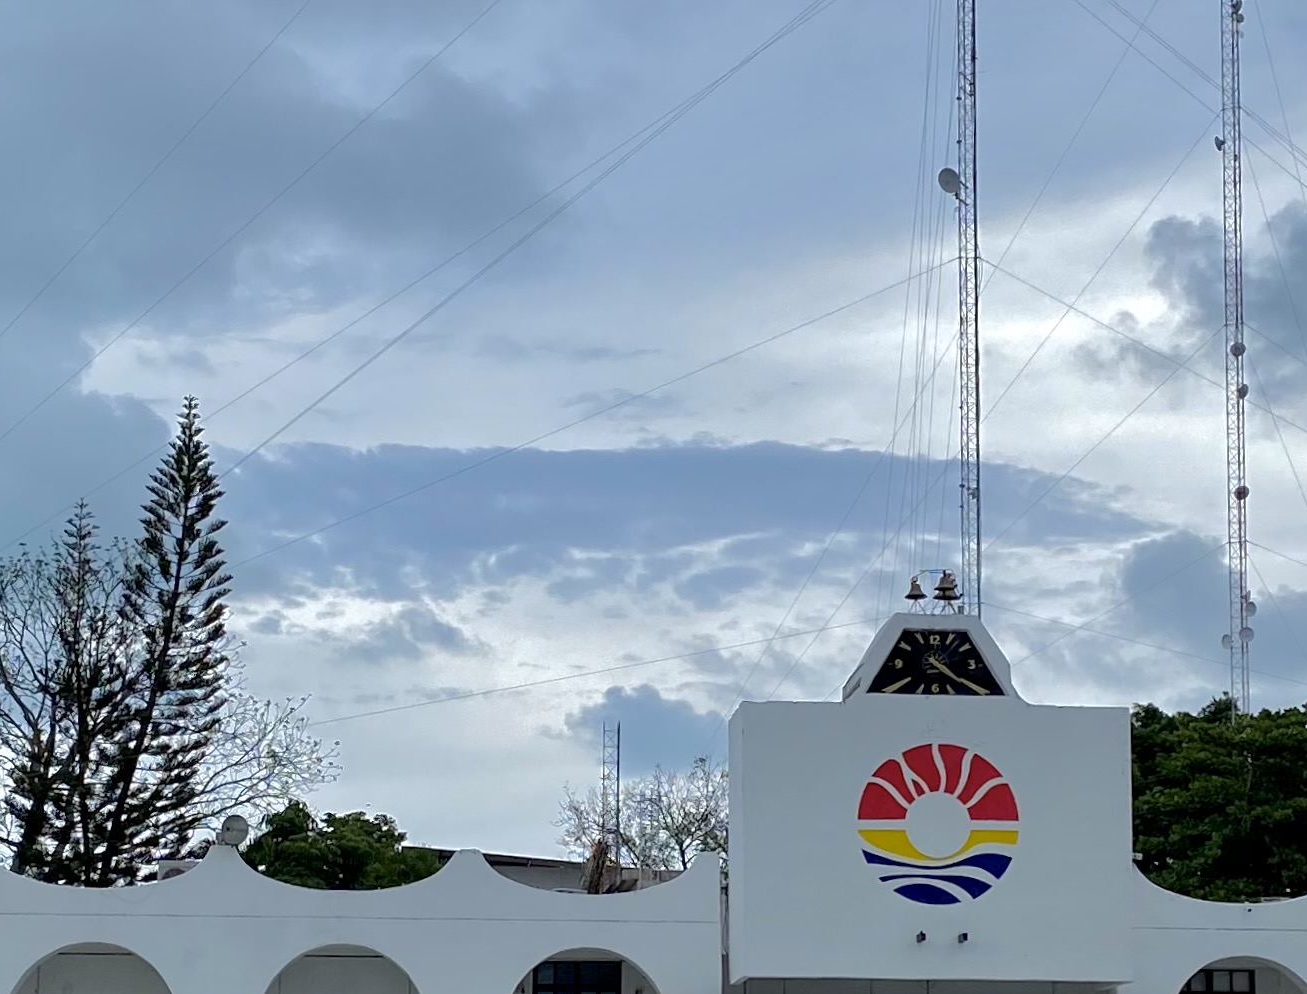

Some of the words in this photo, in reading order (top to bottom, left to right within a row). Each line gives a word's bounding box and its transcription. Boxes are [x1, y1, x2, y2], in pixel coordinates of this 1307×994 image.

[929, 634, 941, 645] 12
[894, 658, 903, 669] 9
[967, 659, 976, 670] 3
[931, 683, 940, 693] 6
